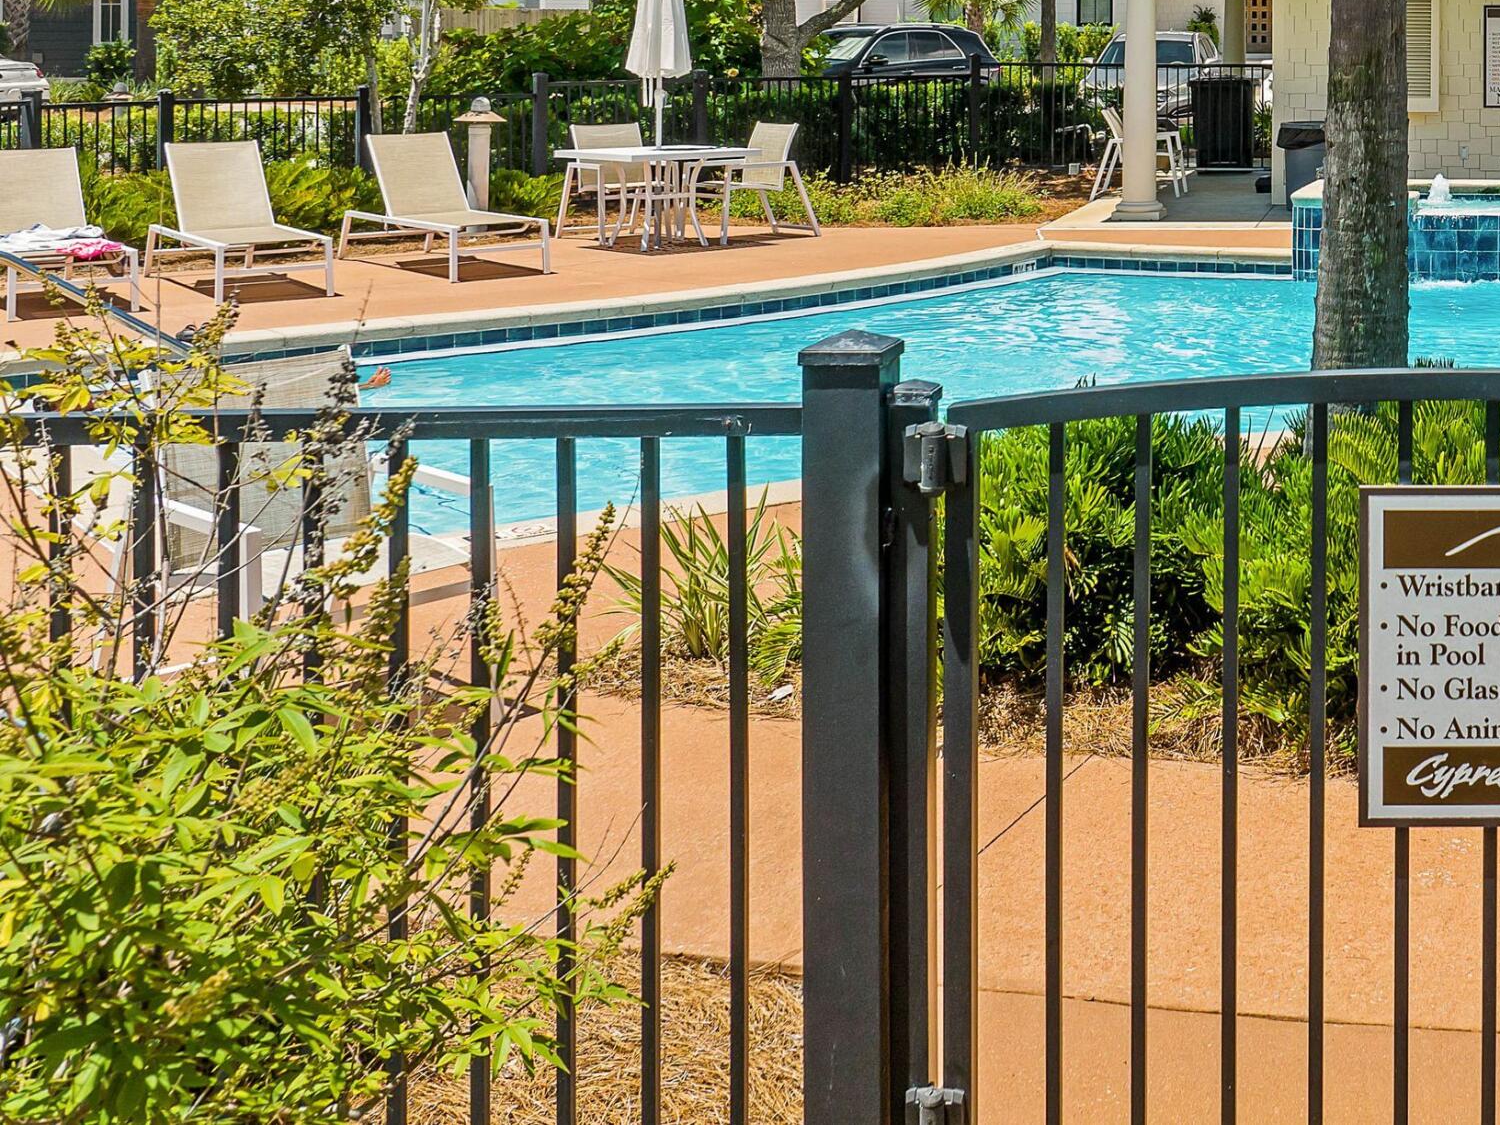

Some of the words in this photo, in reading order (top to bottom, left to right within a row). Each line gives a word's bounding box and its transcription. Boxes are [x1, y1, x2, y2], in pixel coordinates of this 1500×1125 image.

[1396, 615, 1435, 637] No
[1396, 643, 1420, 666] in
[1429, 643, 1486, 666] Pool
[1396, 677, 1435, 700] No
[1396, 717, 1435, 740] No
